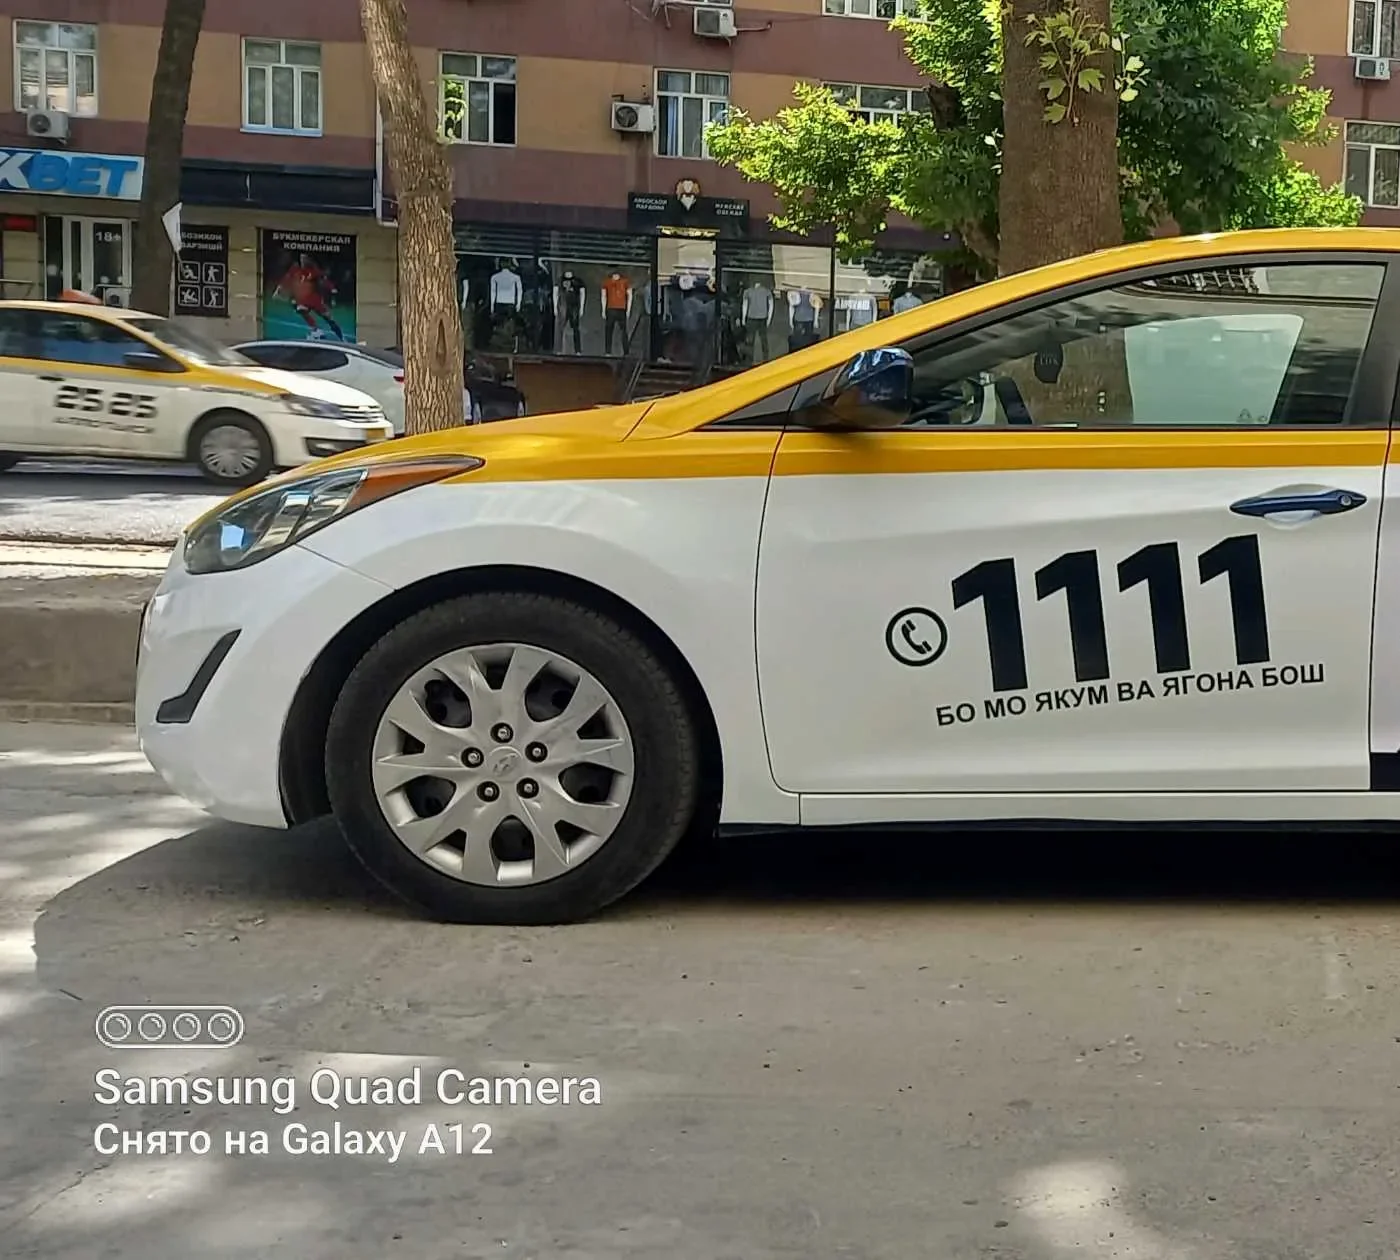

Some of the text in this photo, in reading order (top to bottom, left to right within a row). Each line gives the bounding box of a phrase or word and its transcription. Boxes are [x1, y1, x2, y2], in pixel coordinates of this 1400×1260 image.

[95, 231, 121, 242] 18+
[272, 231, 351, 245] БУКМЕКЕРСКАЯ
[283, 242, 341, 253] КОМПАНИЯ
[951, 533, 1270, 693] 1111
[935, 663, 1325, 726] БО МО ЯКУМ ВА ЯГОНА БОШ
